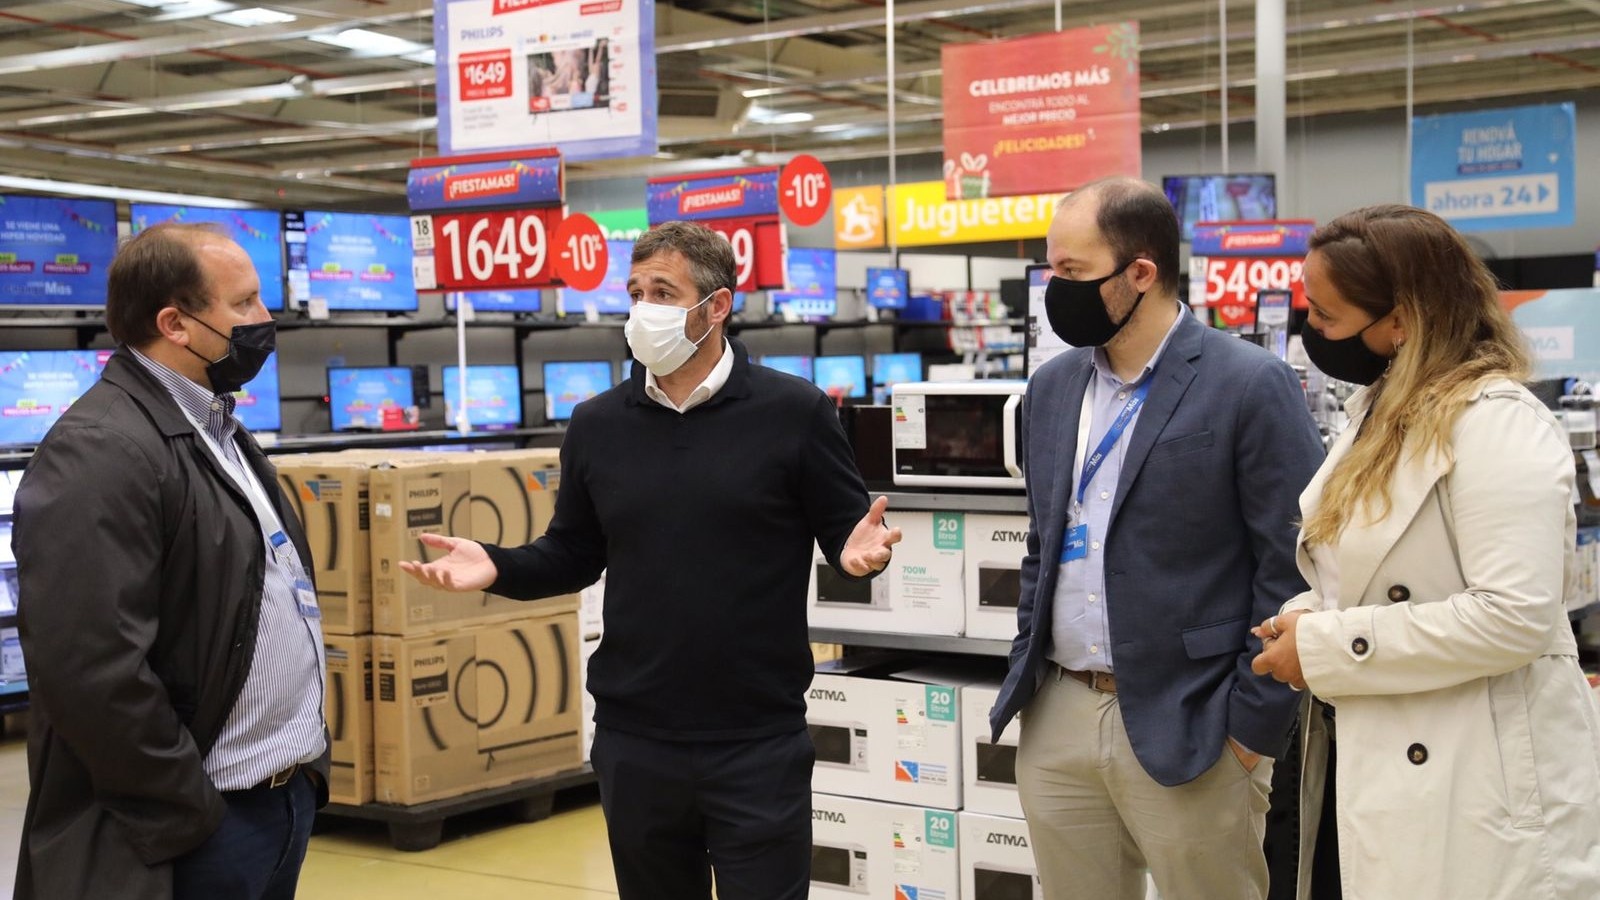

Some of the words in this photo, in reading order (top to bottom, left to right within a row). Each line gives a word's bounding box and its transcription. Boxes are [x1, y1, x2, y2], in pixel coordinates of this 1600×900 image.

[460, 26, 504, 40] PHILIPS
[464, 61, 506, 86] $1649
[969, 71, 1072, 97] CELEBREMOS
[1074, 64, 1110, 87] MÁS
[1002, 111, 1037, 126] MEJOR
[1038, 107, 1076, 123] PRECIO
[1462, 121, 1516, 144] RENOVÁ
[993, 133, 1086, 158] ¡FELICIDADES!
[1458, 146, 1475, 162] TU
[449, 173, 516, 199] ¡FIESTAMAS!
[784, 172, 826, 208] -10%
[683, 188, 742, 213] ¡FIESTAMAS!
[1432, 191, 1494, 211] ahora
[1501, 185, 1532, 206] 24
[415, 220, 430, 236] 18
[442, 215, 548, 281] 1649
[560, 233, 602, 272] -10%
[409, 488, 439, 499] PHILIPS
[938, 518, 957, 532] 20
[903, 565, 926, 575] 700W
[414, 655, 445, 668] PHILIPS
[809, 688, 847, 702] ATMA
[930, 691, 950, 706] 20
[930, 816, 950, 831] 20
[986, 831, 1029, 848] ATMA
